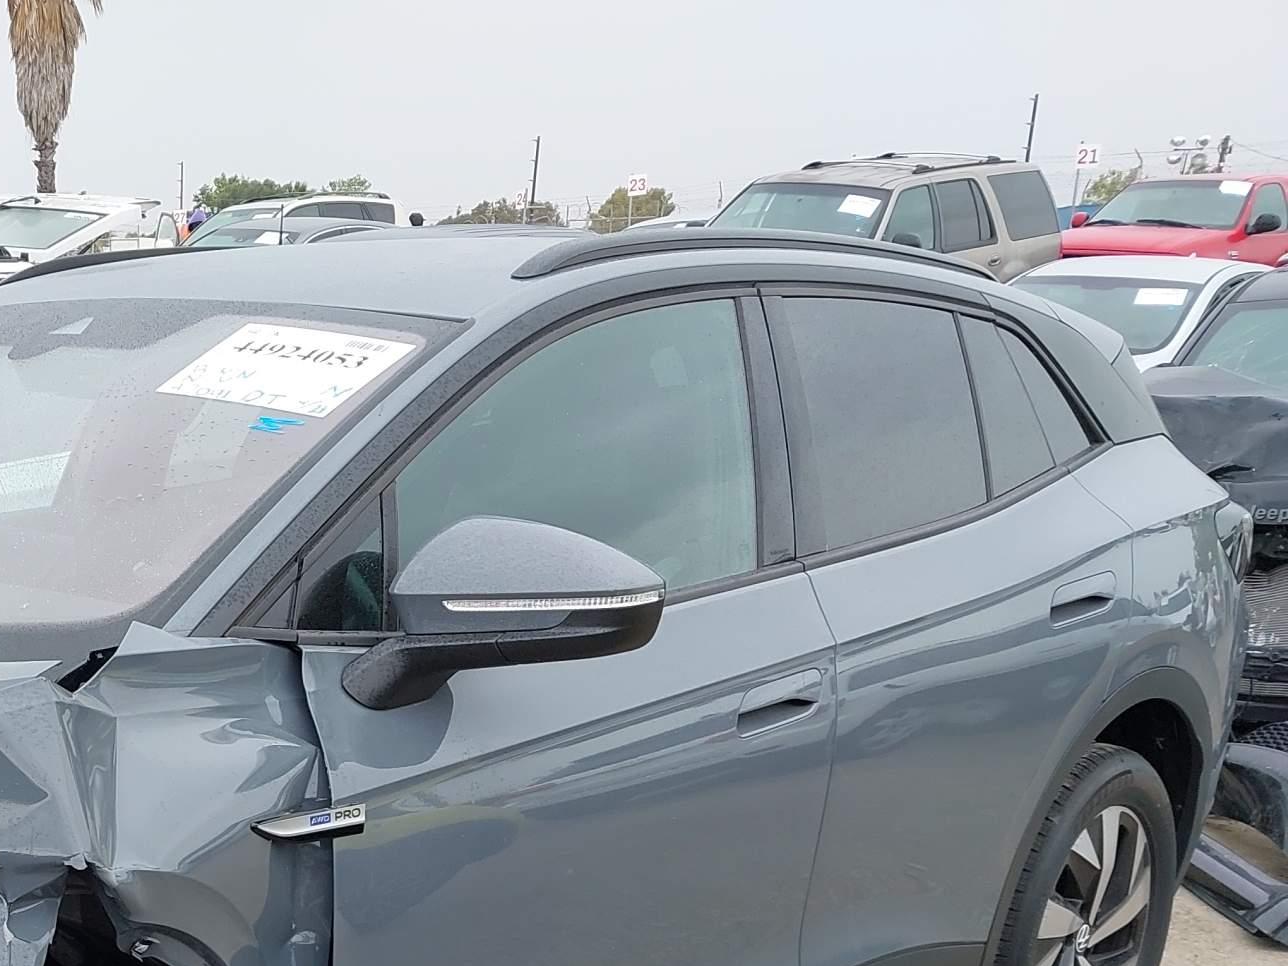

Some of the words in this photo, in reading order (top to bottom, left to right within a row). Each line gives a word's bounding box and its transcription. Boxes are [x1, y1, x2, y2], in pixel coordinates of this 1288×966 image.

[1077, 148, 1098, 165] 21
[629, 177, 646, 193] 23
[233, 340, 369, 369] 44924053
[334, 807, 361, 821] PRO
